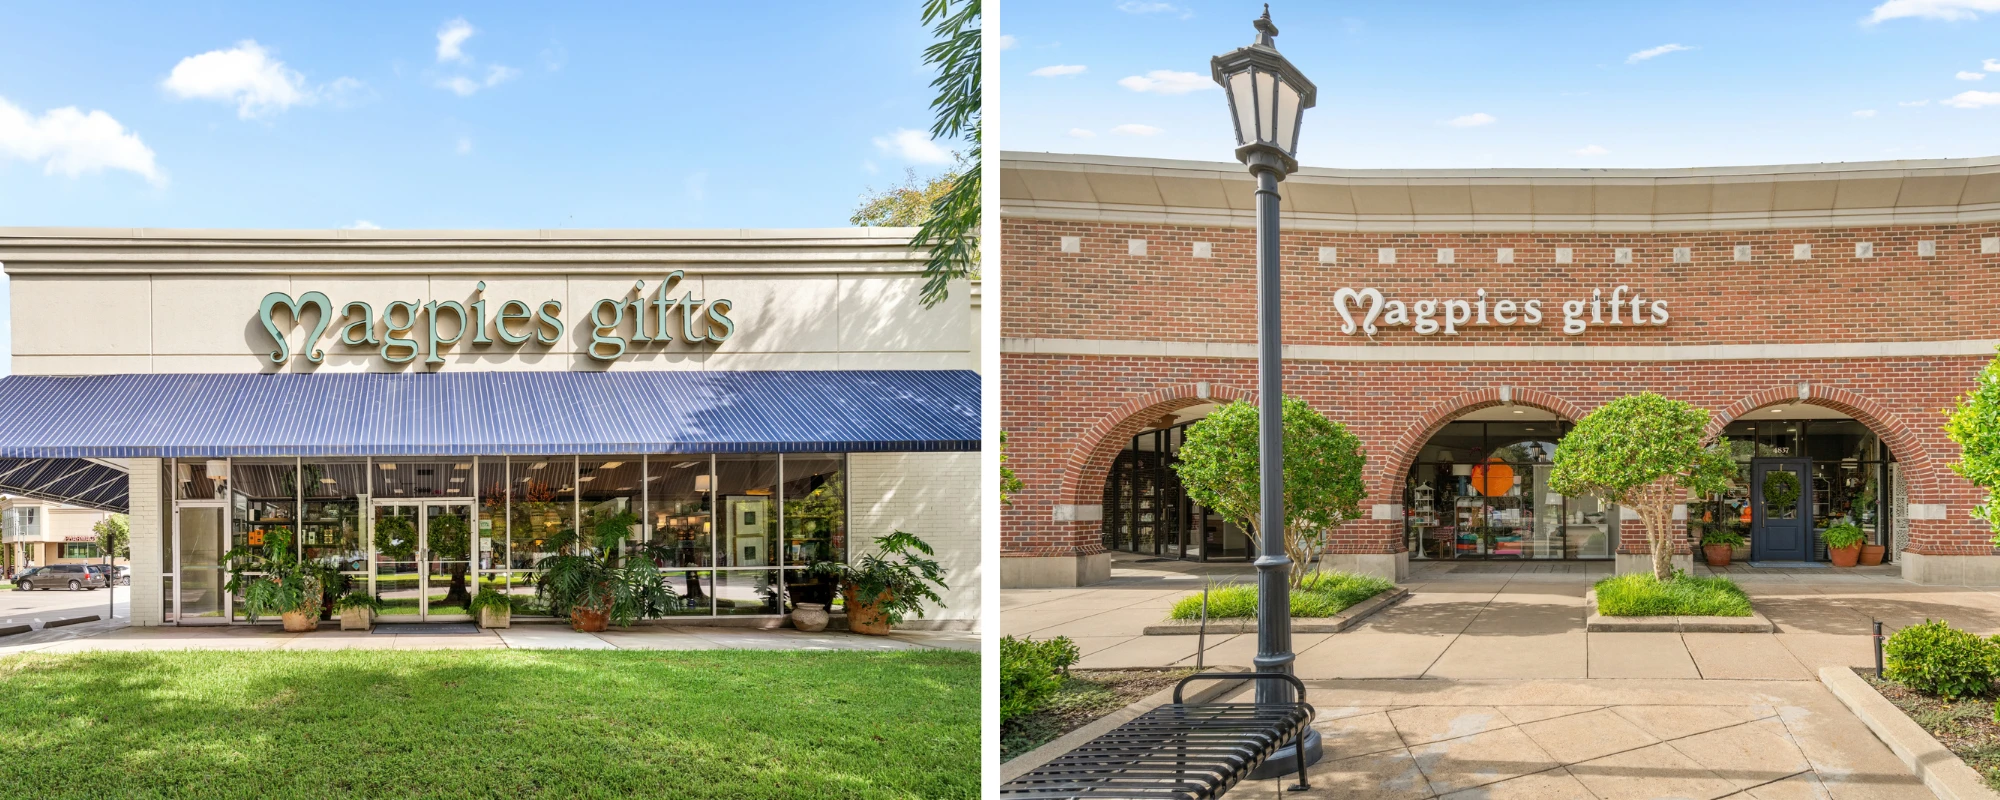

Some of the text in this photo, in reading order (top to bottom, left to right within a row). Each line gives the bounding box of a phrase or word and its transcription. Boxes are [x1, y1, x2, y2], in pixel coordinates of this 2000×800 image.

[259, 269, 736, 364] Magpies gifts
[1333, 284, 1670, 337] Magpies gifts
